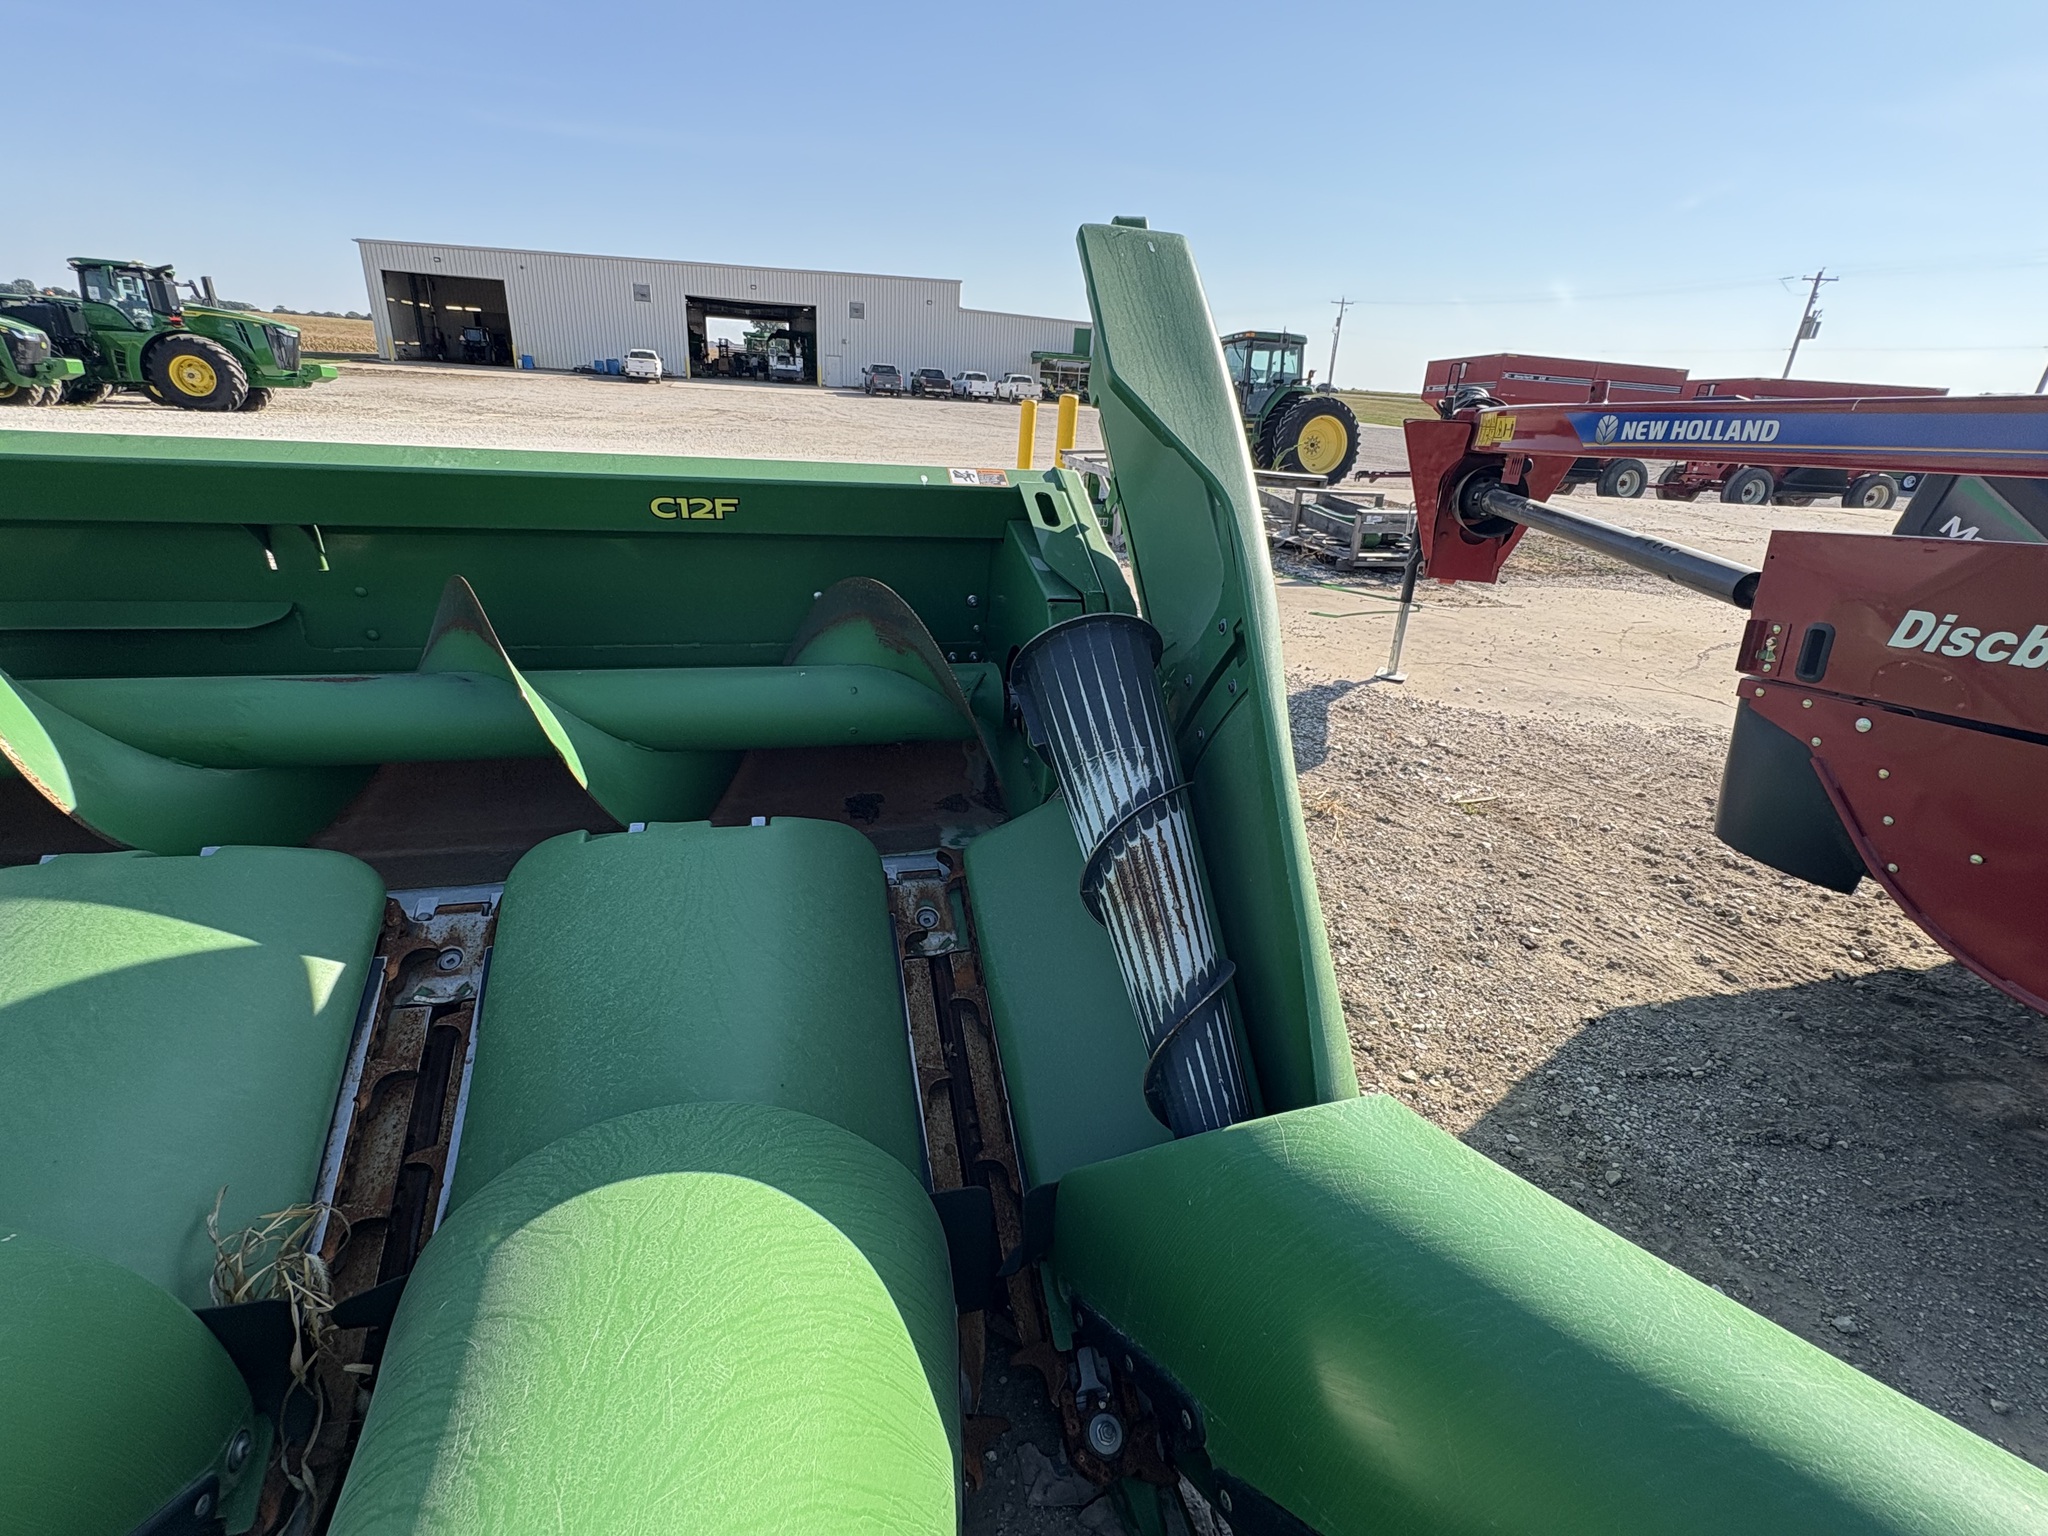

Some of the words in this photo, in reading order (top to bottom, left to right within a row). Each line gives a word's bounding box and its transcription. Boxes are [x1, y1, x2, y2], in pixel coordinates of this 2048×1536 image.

[1620, 420, 1670, 440] NEW
[1669, 419, 1781, 442] HOLLAND
[649, 496, 740, 520] C12F
